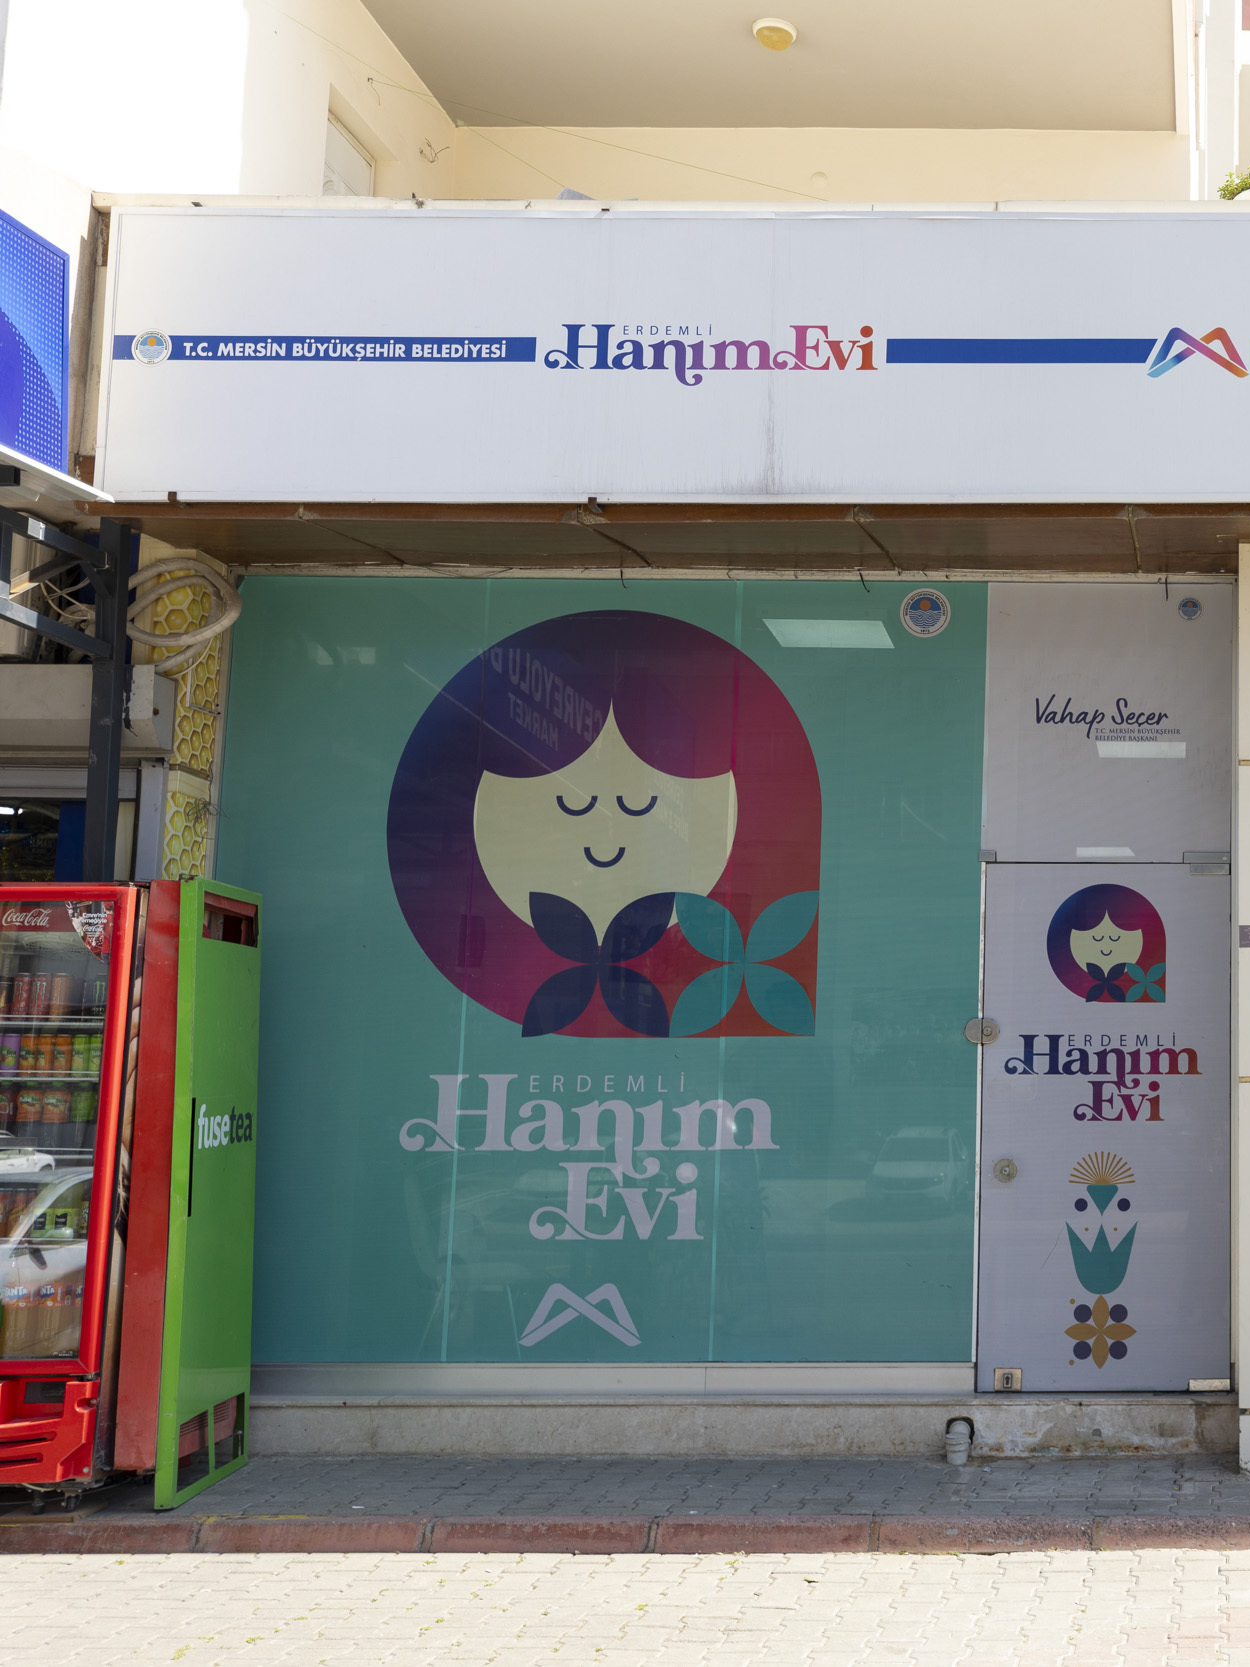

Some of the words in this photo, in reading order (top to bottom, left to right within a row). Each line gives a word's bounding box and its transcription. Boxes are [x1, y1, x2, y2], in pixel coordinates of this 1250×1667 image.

[623, 324, 713, 336] ERDEMLİ
[183, 342, 213, 357] T.C.
[217, 338, 287, 357] MERSİN
[292, 338, 406, 361] BÜYÜKŞEHİR
[411, 340, 507, 358] BELEDİYESİ
[1035, 694, 1105, 739] Vahap
[1111, 698, 1168, 728] Seçer
[1109, 727, 1135, 735] MERSİN
[2, 908, 53, 927] Coca-Cola
[1068, 1032, 1176, 1047] ERDEMLİ
[1004, 1034, 1203, 1089] Hanım
[529, 1072, 685, 1093] ERDEMLİ
[1073, 1080, 1165, 1122] Evi
[399, 1074, 780, 1179] Hanım
[529, 1162, 704, 1240] Evi
